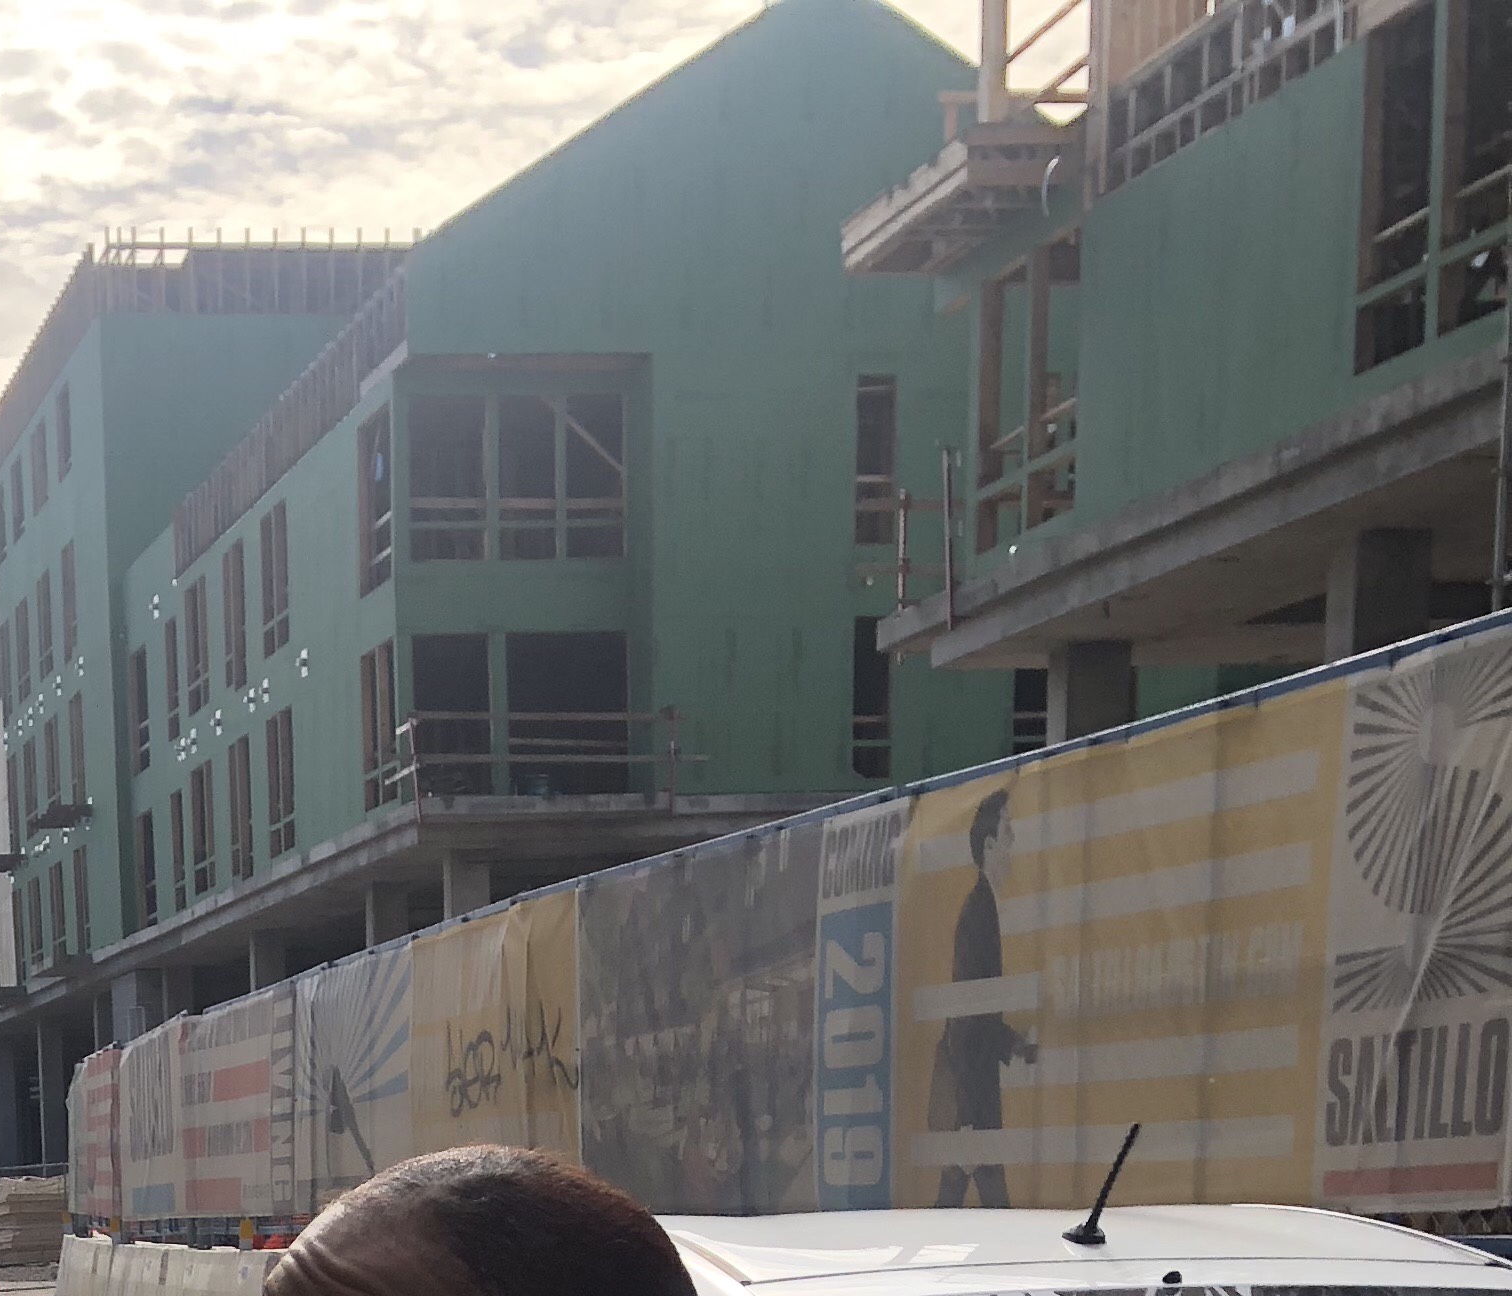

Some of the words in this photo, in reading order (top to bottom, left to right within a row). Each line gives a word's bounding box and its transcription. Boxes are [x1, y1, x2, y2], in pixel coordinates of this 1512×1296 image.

[271, 996, 295, 1202] LIVING
[824, 931, 885, 1187] 2019
[1325, 1017, 1510, 1147] SALTILLO
